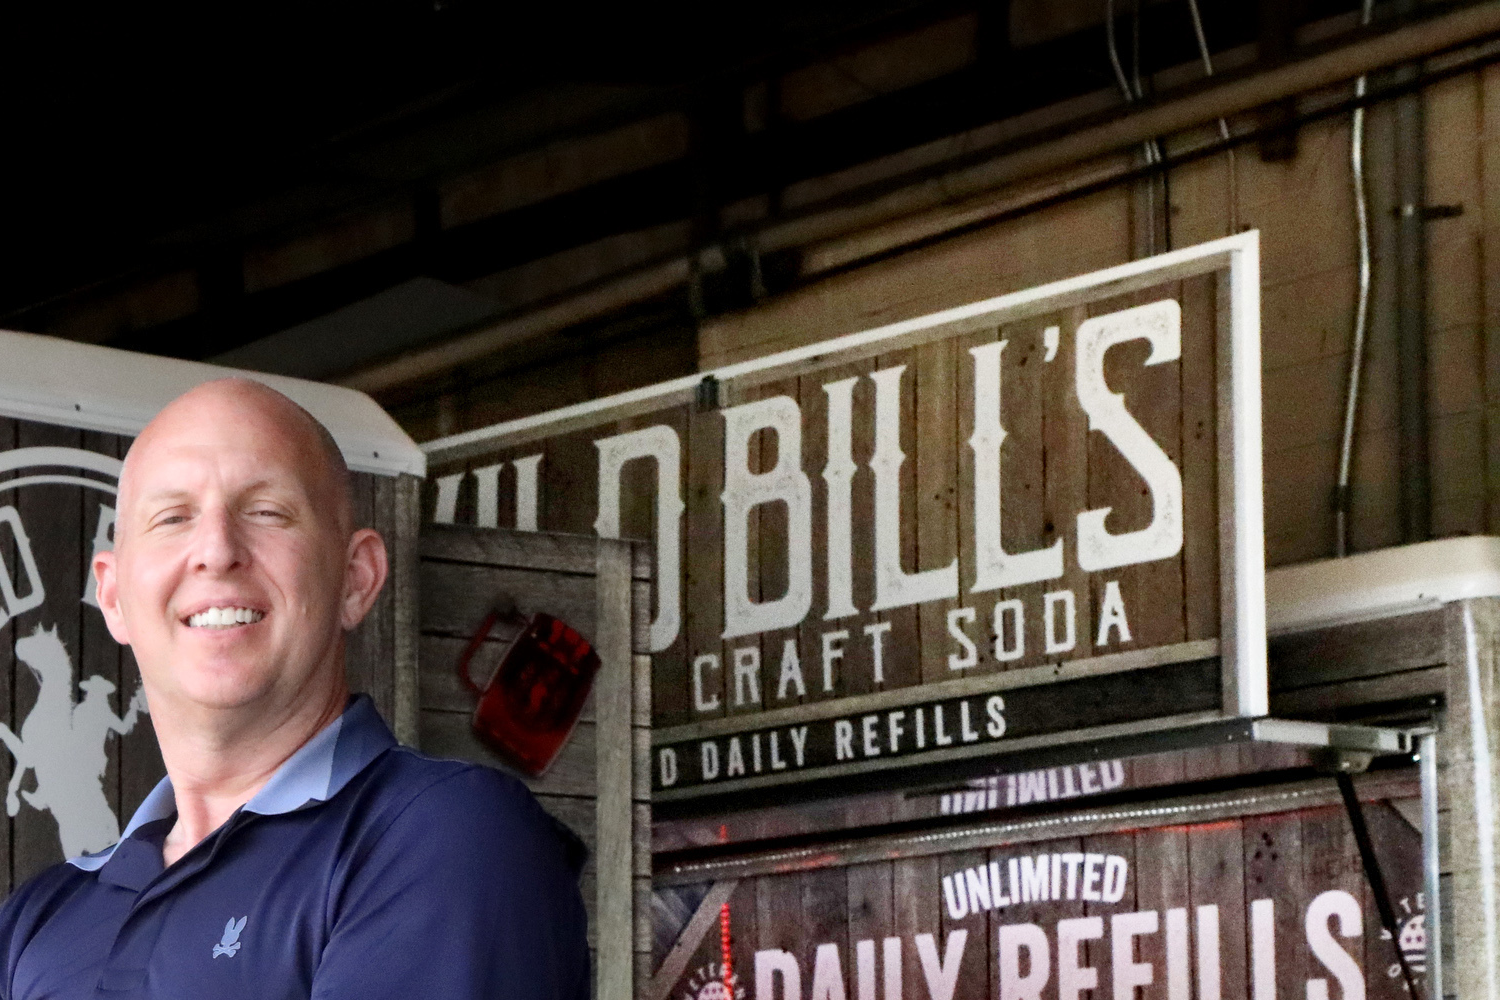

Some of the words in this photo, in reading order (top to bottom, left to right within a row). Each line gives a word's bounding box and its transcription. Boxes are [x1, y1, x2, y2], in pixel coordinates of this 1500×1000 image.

[721, 299, 1184, 638] BILL'S
[692, 622, 892, 712] CRAFT
[948, 581, 1134, 671] SODA
[702, 726, 809, 781] DAILY
[836, 696, 1008, 759] REFILLS
[943, 853, 1128, 920] UNLIMITED
